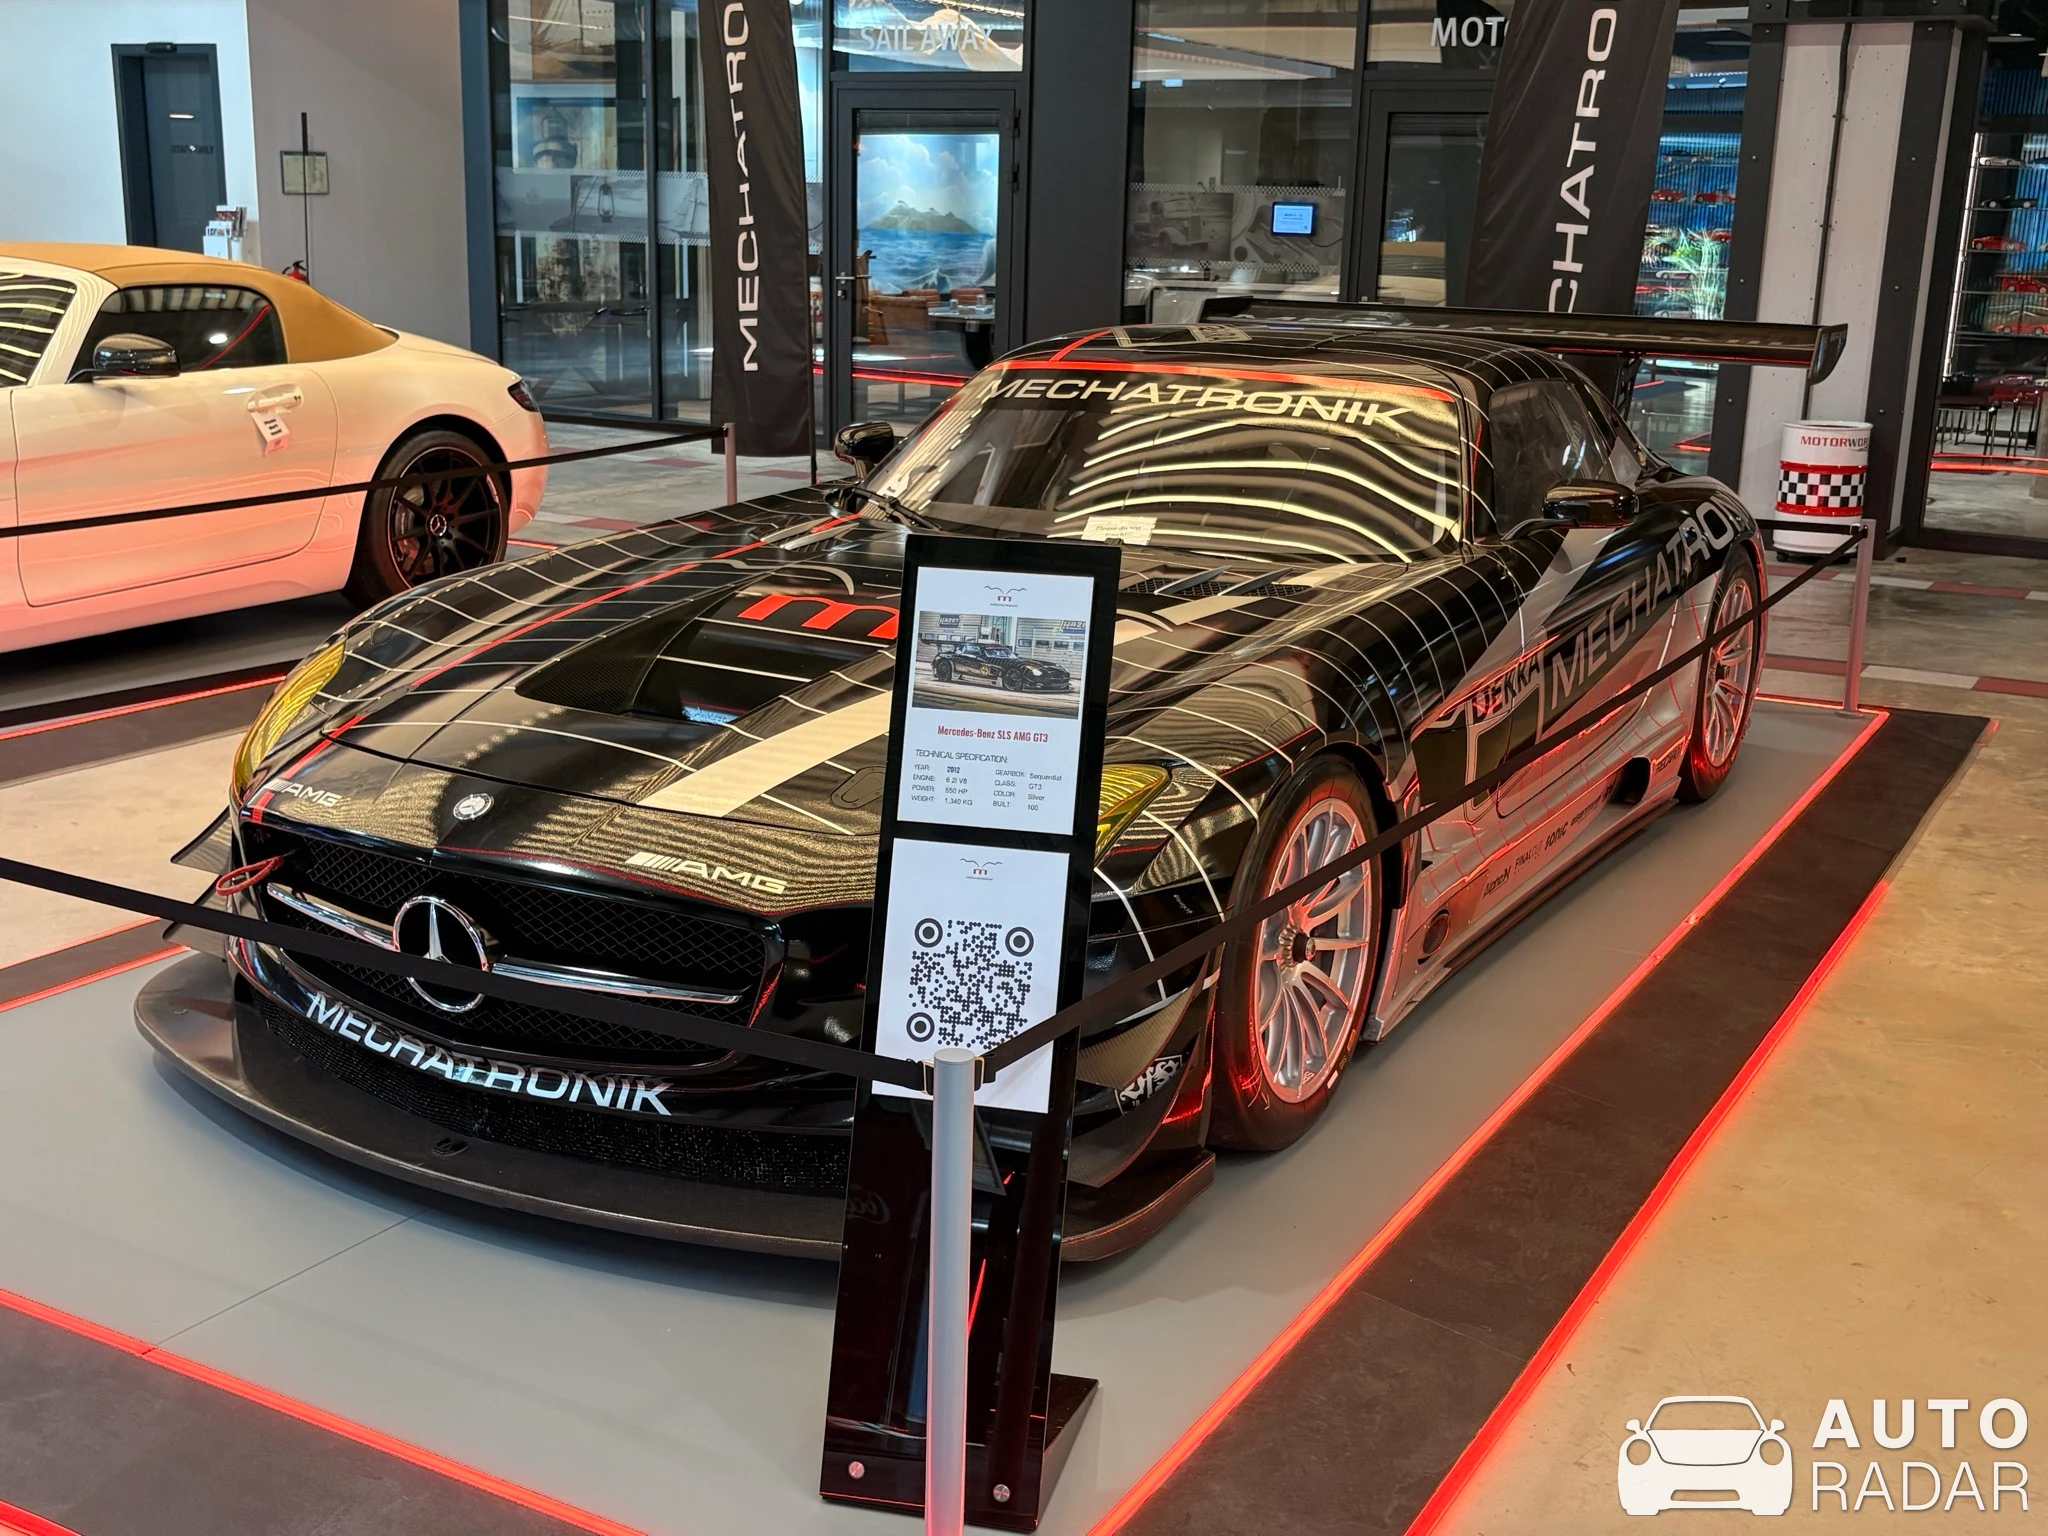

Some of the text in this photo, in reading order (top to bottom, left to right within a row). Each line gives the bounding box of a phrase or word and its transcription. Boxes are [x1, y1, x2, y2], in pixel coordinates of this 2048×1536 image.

[860, 23, 995, 51] SAIL AWAY
[1430, 16, 1510, 47] MOT
[979, 378, 1416, 431] MECHATRONIK
[1471, 645, 1541, 722] DEKRA
[937, 725, 1049, 743] Mercedes-Benz SLS AMG GT3
[915, 749, 1009, 764] TECHNICAL SPECIFICATION:
[946, 766, 961, 774] 2012
[281, 782, 342, 807] AMG
[1027, 793, 1045, 801] Silver
[671, 859, 787, 895] AMG
[305, 990, 675, 1116] MECHATRONIK
